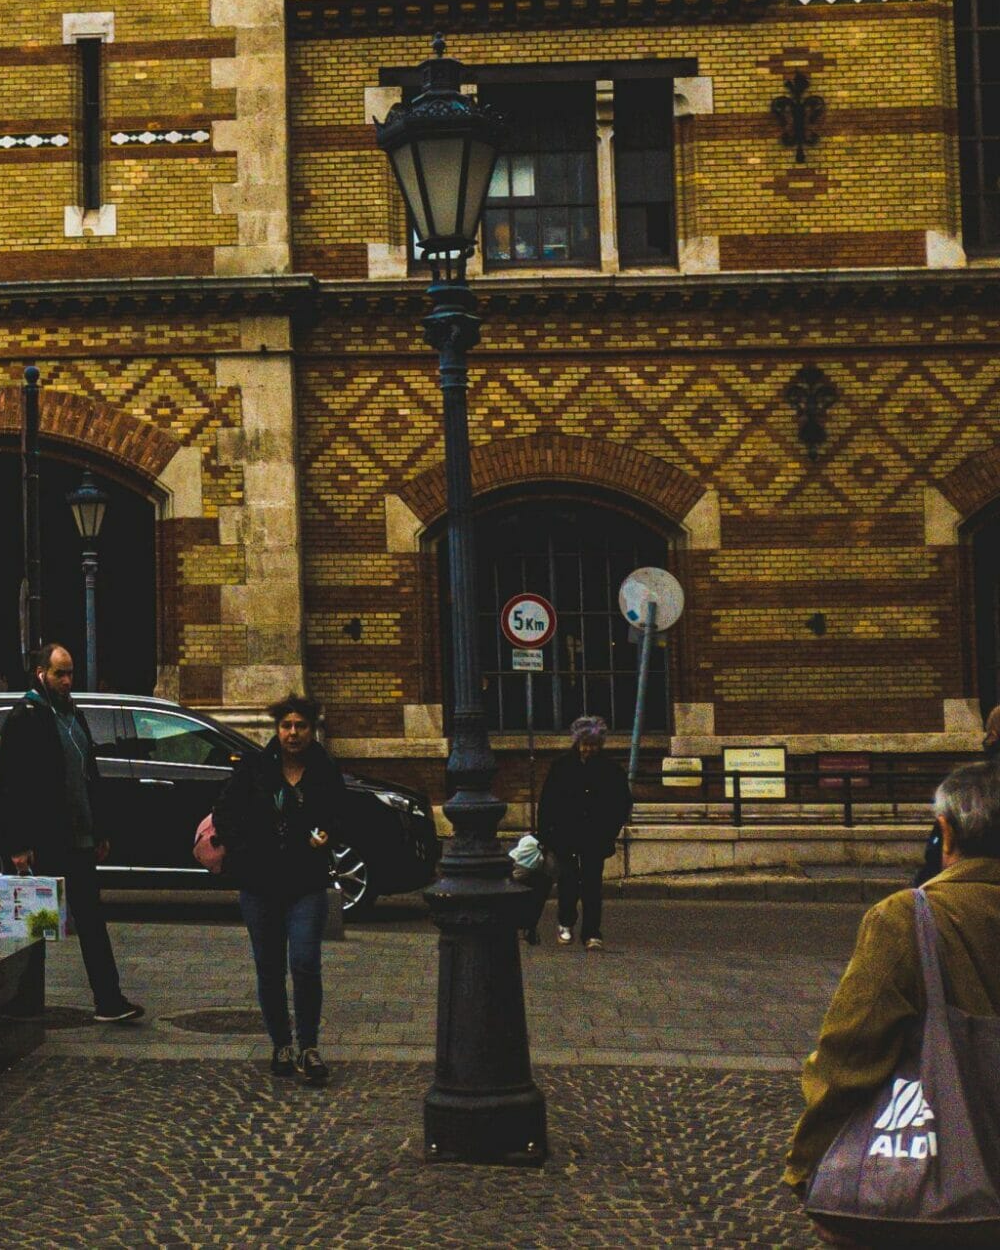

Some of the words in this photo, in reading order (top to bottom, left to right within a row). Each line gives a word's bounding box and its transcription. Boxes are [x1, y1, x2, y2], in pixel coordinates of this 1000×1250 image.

[513, 611, 524, 631] 5
[526, 618, 545, 631] Km
[869, 1131, 938, 1159] ALDI
